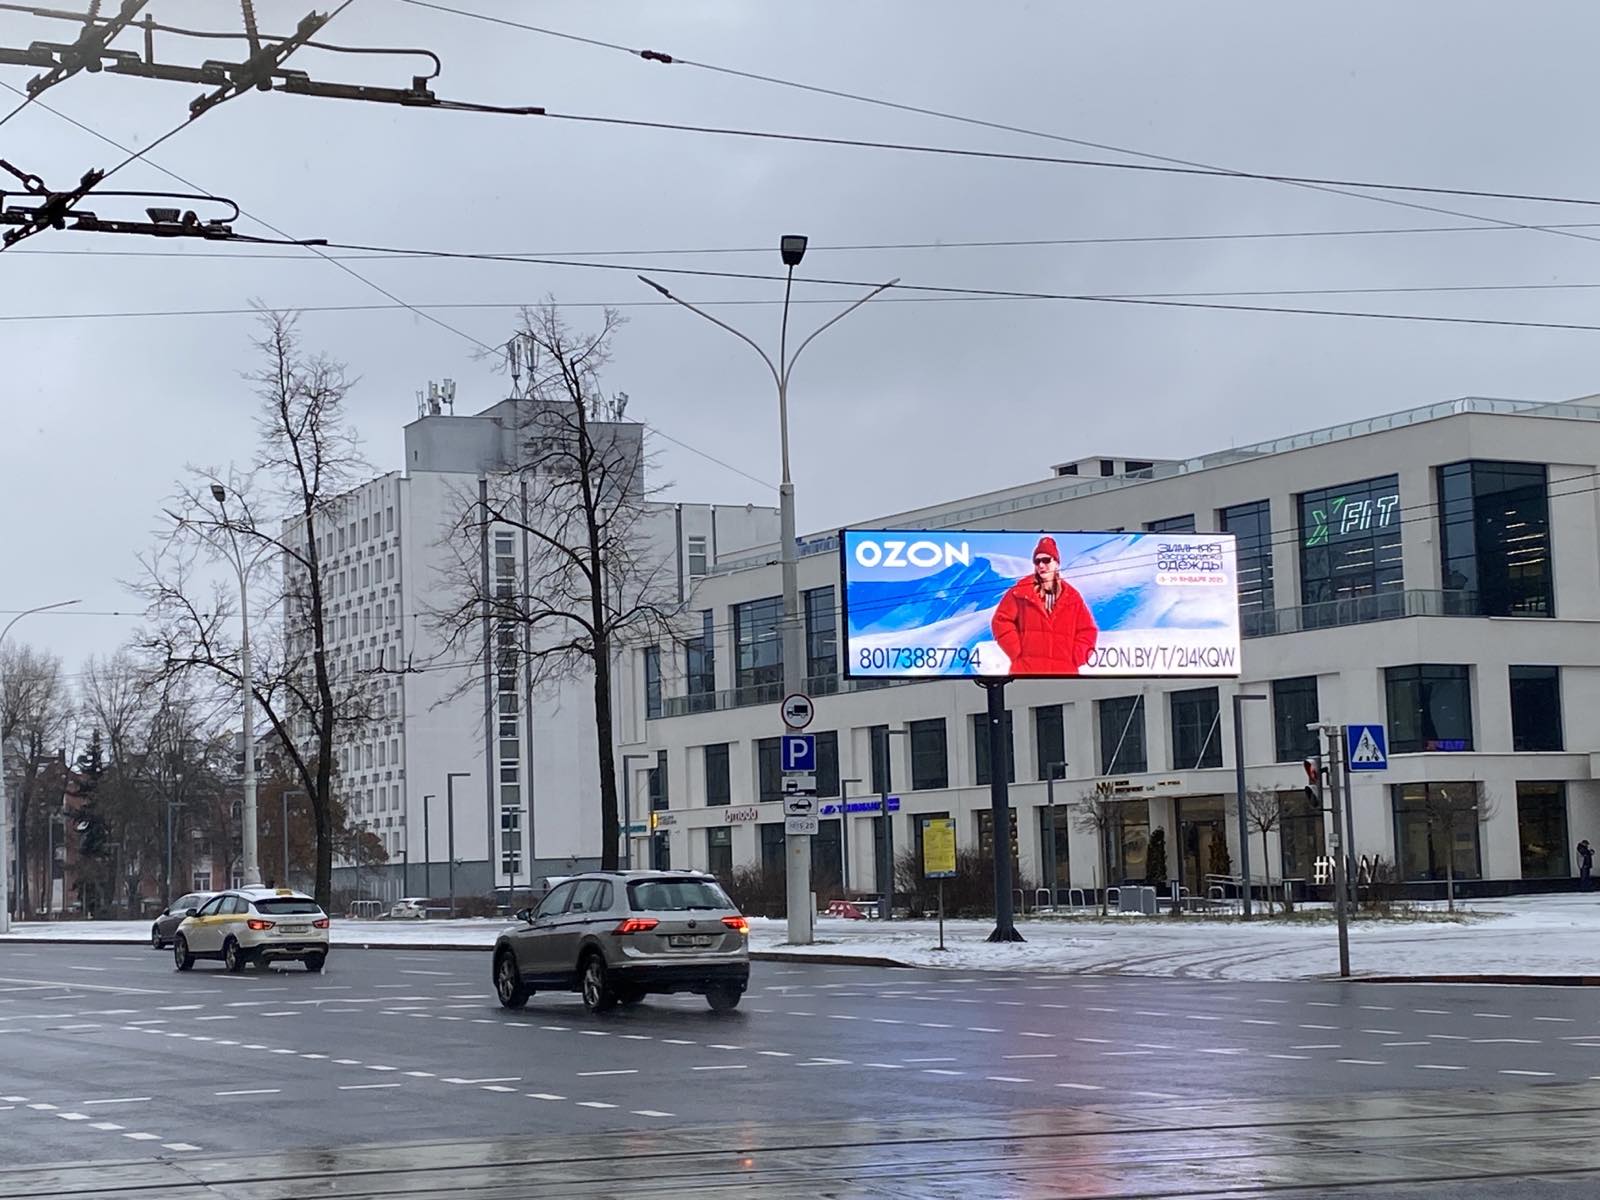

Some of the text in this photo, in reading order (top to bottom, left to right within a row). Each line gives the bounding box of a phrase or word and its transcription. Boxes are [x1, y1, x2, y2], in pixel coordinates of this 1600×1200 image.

[855, 541, 970, 568] OZON
[859, 647, 982, 669] 80173887794
[789, 739, 809, 768] P
